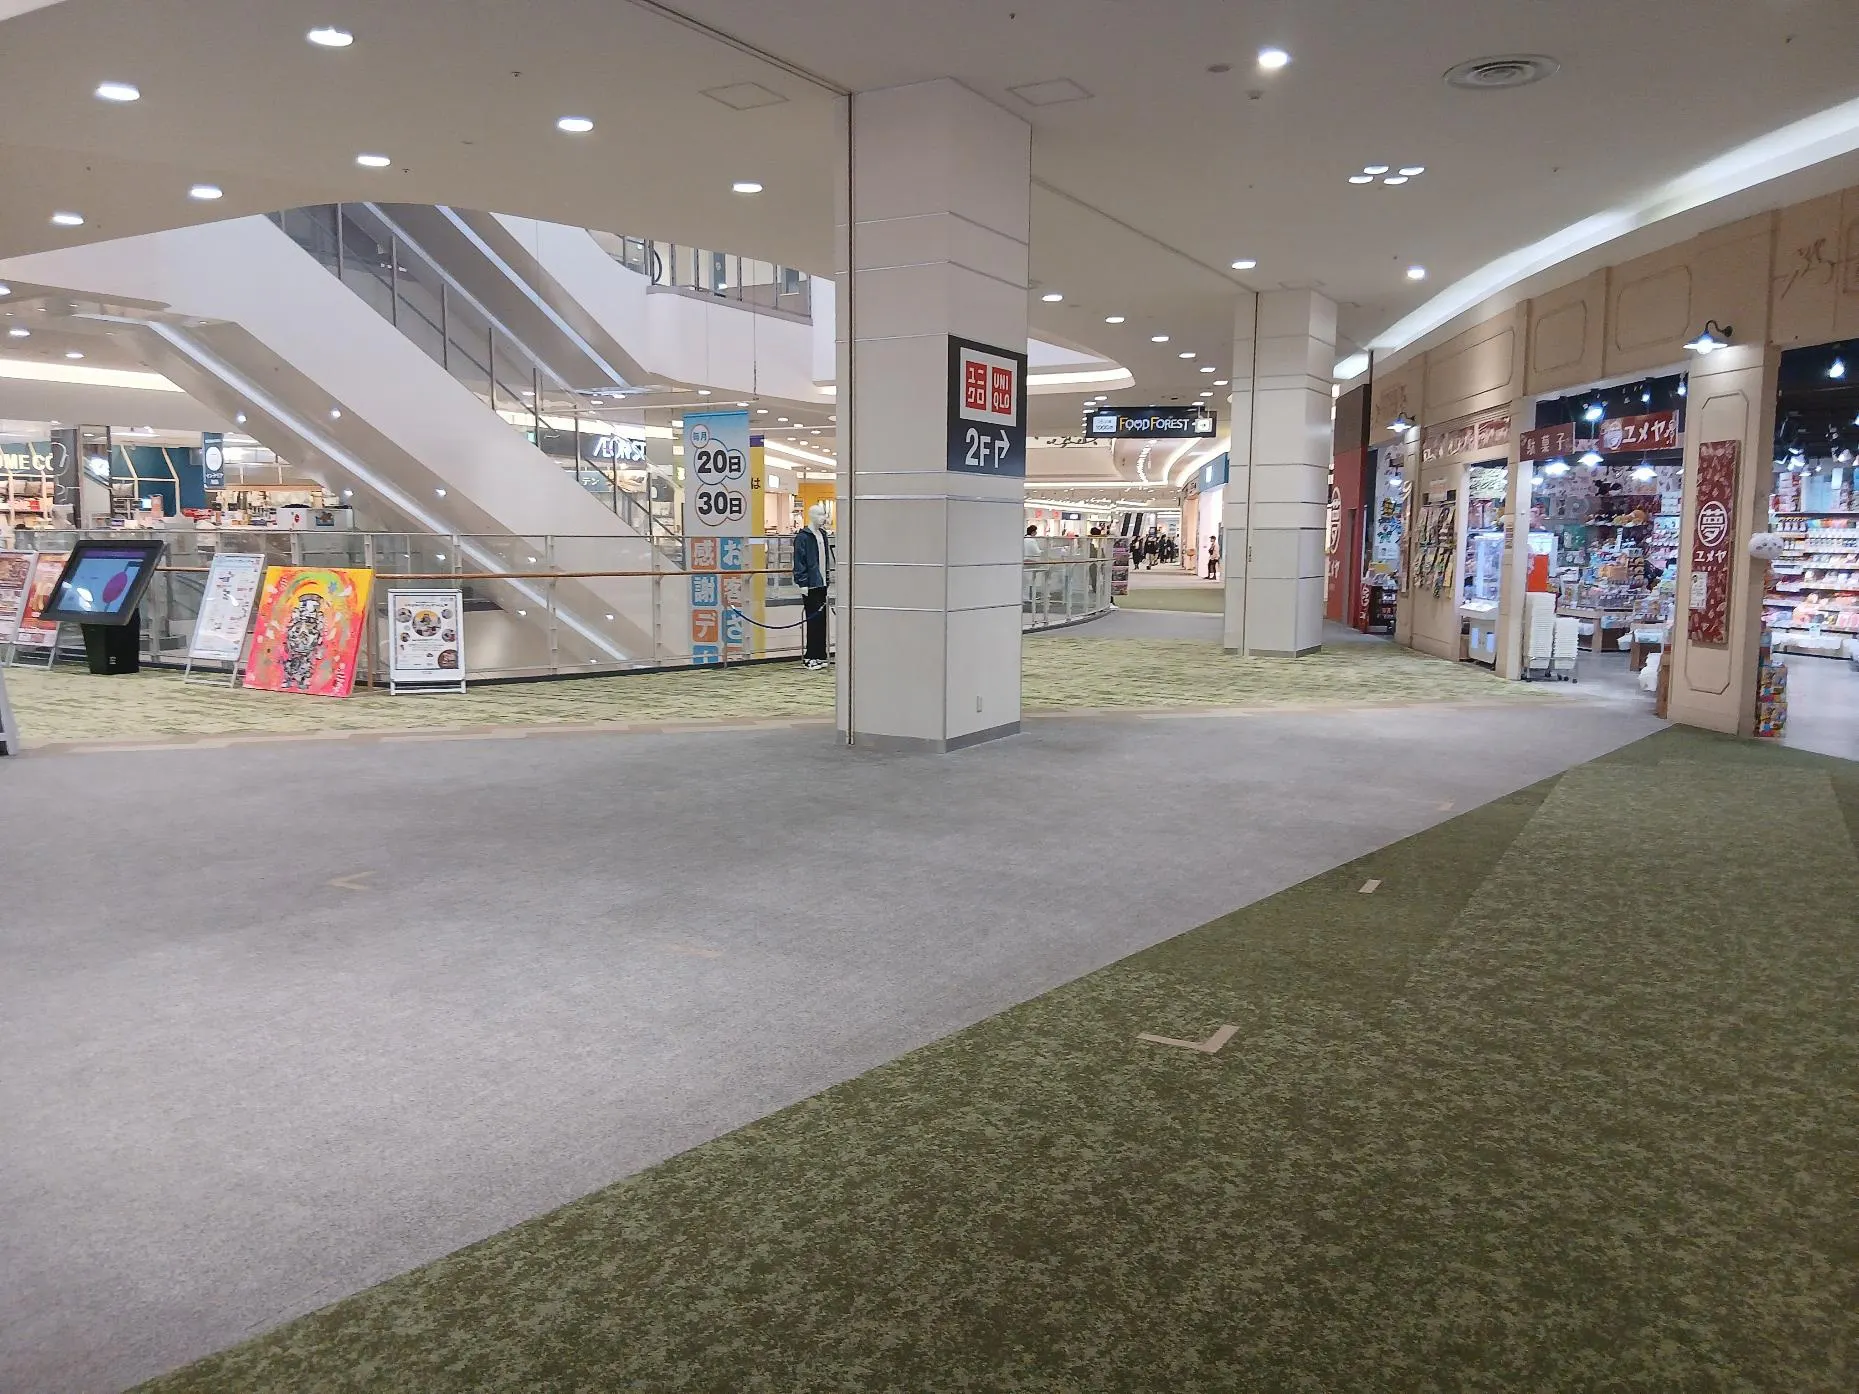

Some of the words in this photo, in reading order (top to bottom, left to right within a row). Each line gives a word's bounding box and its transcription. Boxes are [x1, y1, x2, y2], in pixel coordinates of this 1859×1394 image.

[994, 372, 1009, 391] UNI
[967, 387, 985, 404] クロ
[993, 391, 1010, 410] QLO
[965, 427, 991, 467] 2F
[0, 452, 31, 471] ME
[697, 449, 742, 474] 20日
[698, 491, 742, 515] 30日
[1694, 549, 1728, 564] ユメヤ
